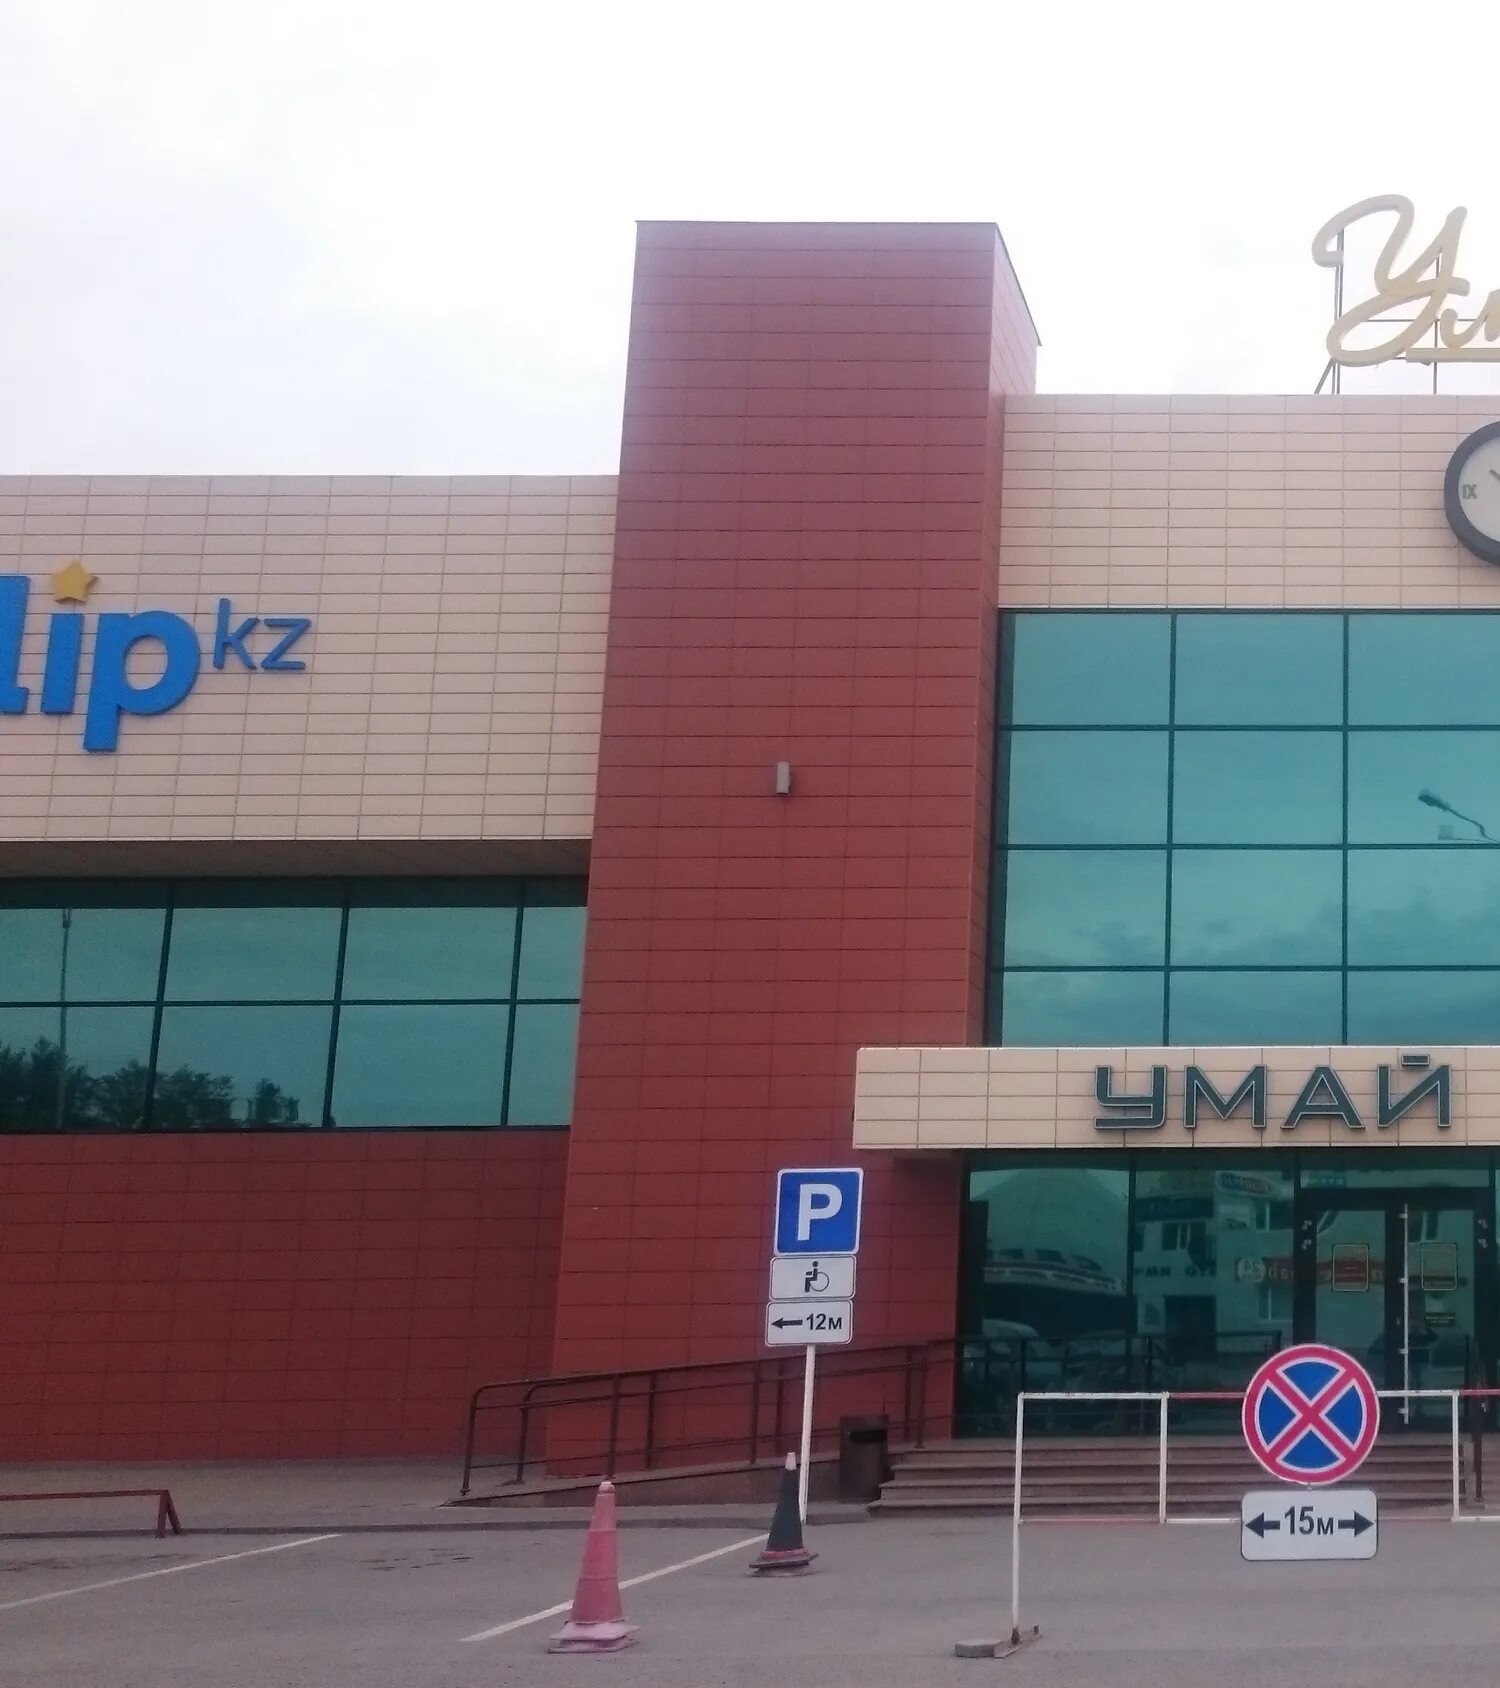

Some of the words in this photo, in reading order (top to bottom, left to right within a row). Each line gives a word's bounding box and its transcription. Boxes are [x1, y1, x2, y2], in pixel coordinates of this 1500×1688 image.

[1462, 484, 1478, 499] IX
[1094, 1054, 1452, 1131] УМАЙ
[797, 1183, 843, 1241] P
